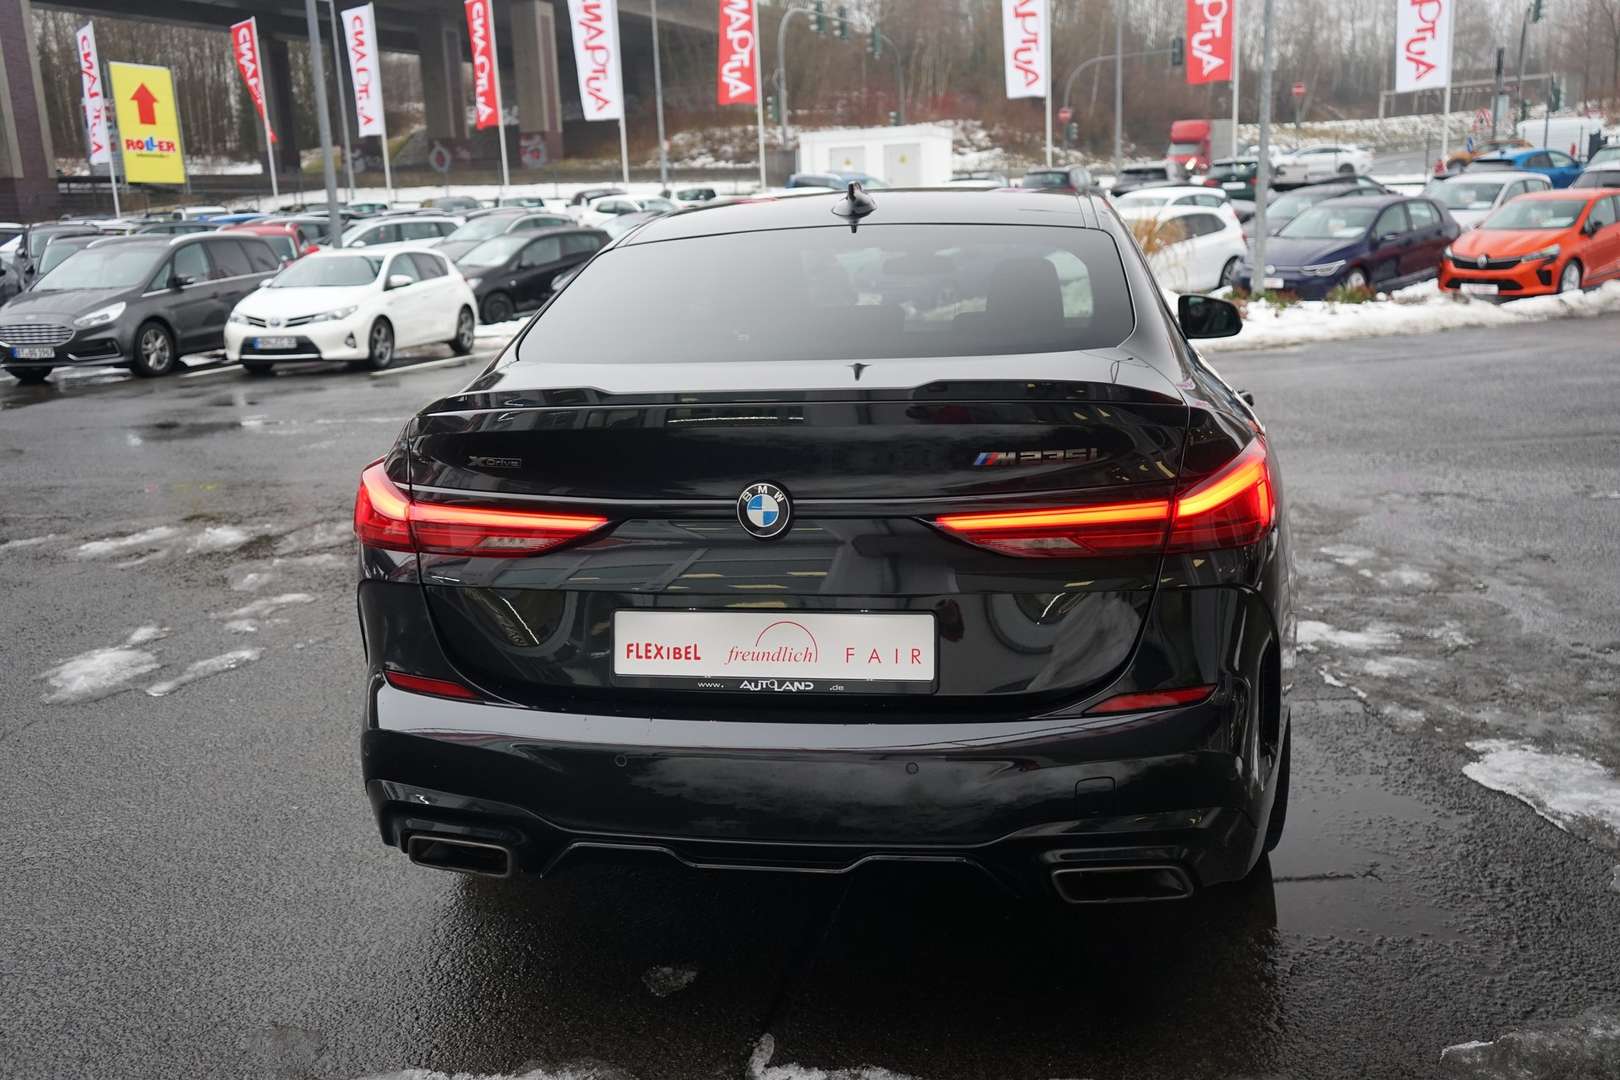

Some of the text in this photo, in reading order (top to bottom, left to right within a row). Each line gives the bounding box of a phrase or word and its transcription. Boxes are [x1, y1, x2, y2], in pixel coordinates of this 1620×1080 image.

[125, 136, 176, 152] ROLLER
[742, 485, 785, 503] BMW
[626, 642, 922, 665] FLEXIBEL freundlich FAIR
[739, 679, 815, 692] AUTOLAND
